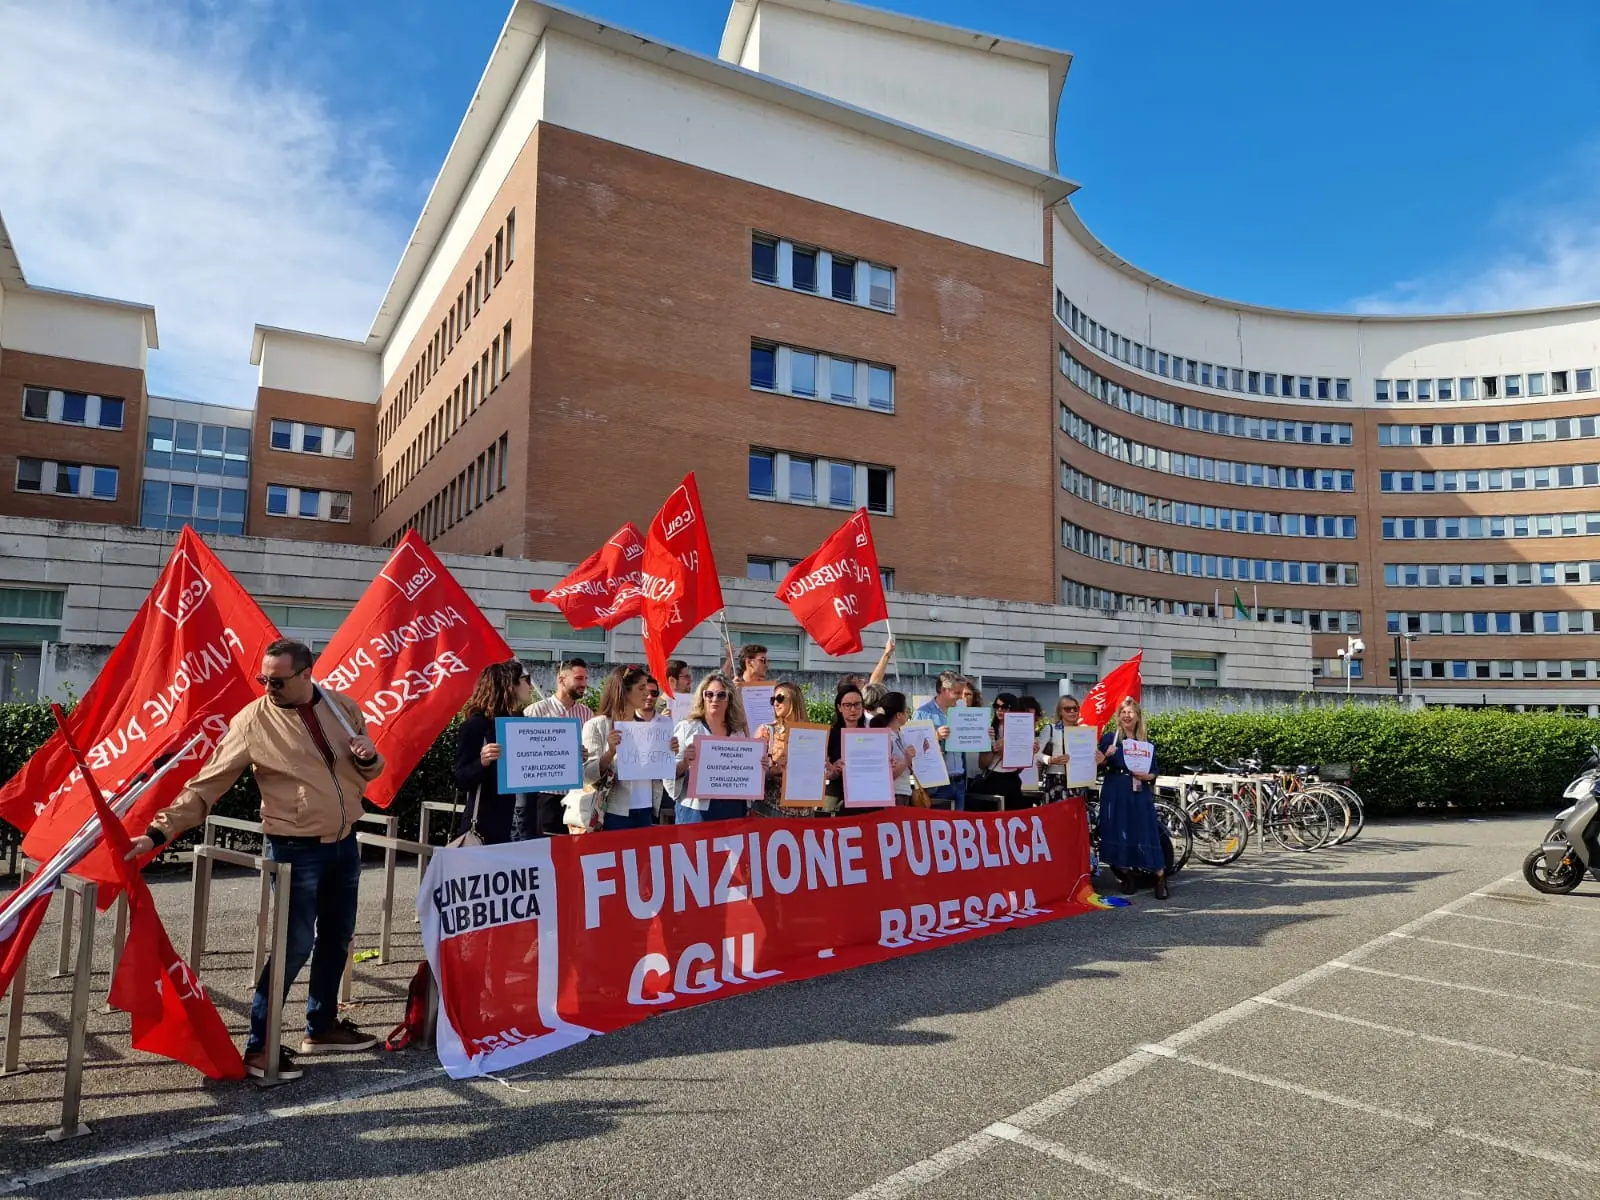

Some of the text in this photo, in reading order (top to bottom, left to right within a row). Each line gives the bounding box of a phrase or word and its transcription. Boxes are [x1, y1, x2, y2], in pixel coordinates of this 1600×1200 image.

[441, 893, 541, 935] UBBLICA
[579, 815, 1053, 930] FUNZIONE PUBBLICA
[626, 932, 784, 1006] CGIL
[878, 888, 1053, 948] BRESCIA
